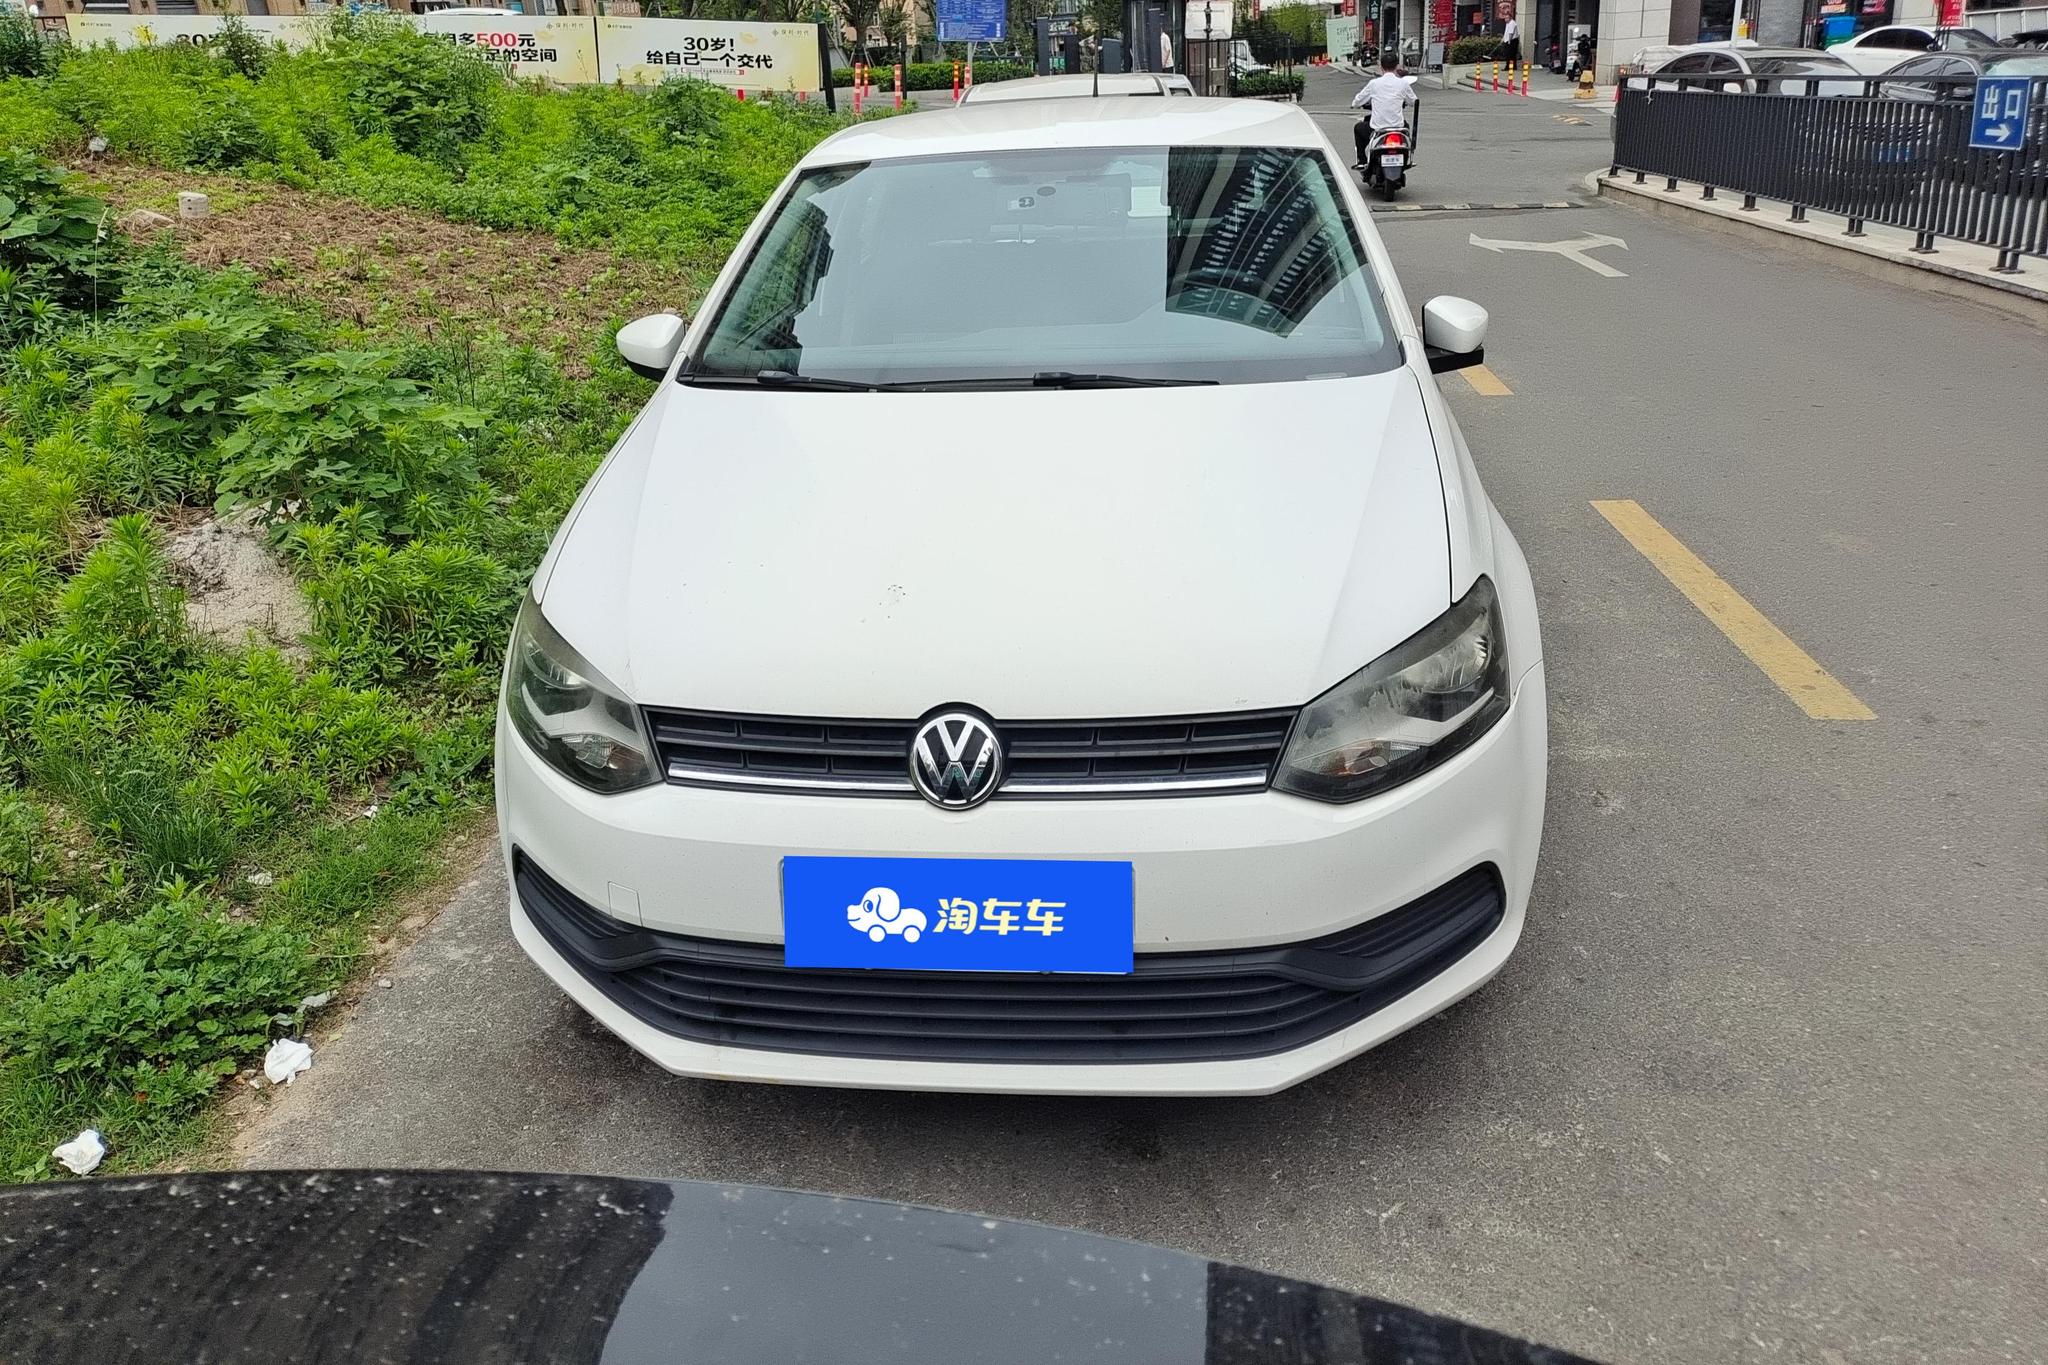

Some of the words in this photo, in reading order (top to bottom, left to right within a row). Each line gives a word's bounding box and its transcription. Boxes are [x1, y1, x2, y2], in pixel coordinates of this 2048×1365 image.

[683, 36, 735, 52] 30岁!
[646, 50, 773, 69] 给自己一个交代
[1981, 85, 2022, 121] 出口
